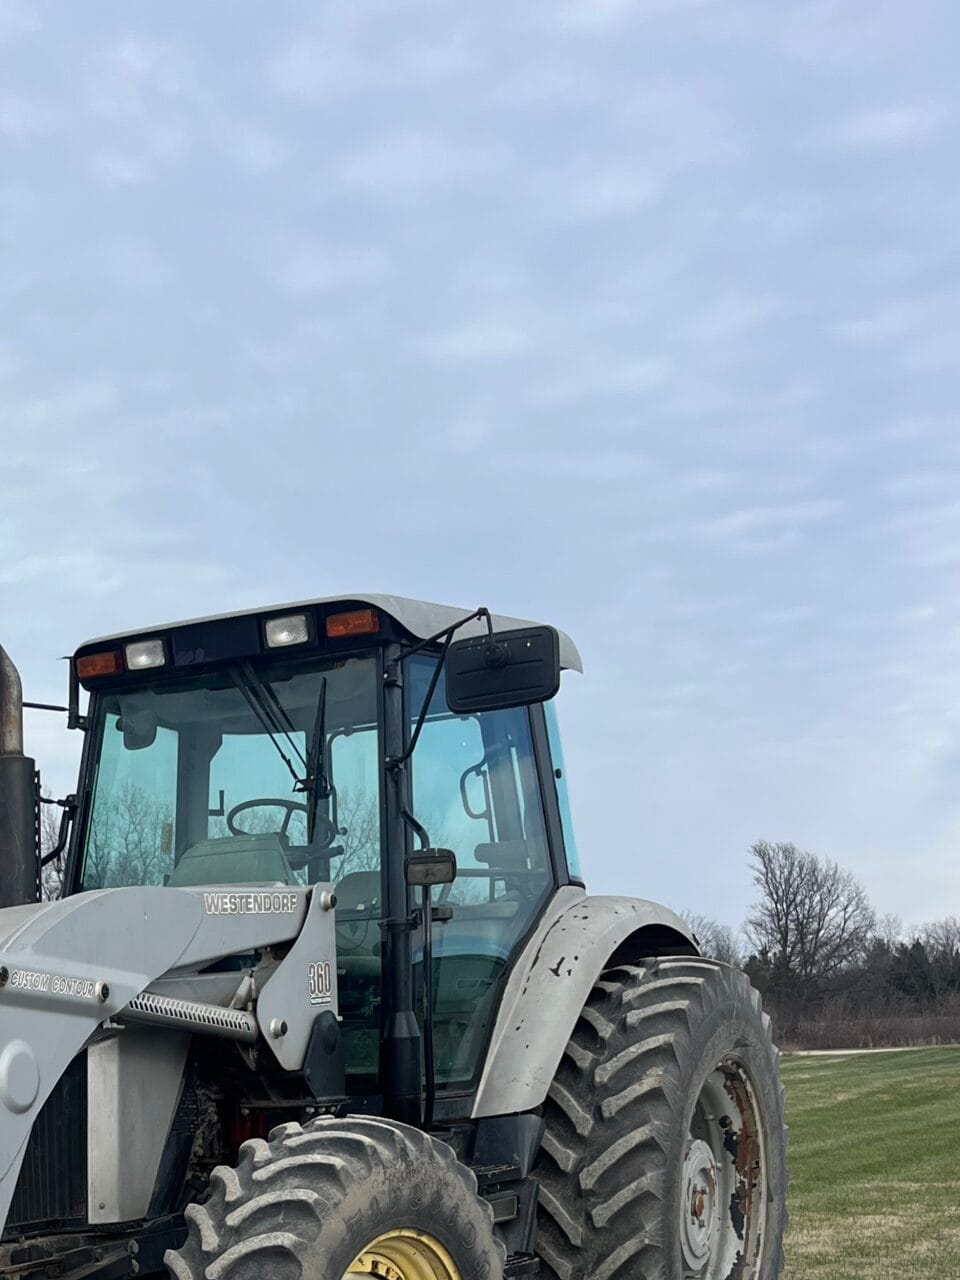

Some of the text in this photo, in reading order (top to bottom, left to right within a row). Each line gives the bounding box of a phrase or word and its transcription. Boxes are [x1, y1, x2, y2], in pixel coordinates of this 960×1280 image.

[204, 893, 297, 914] WESTENDORF
[10, 969, 95, 998] CUSTOM CONTOUR
[308, 961, 332, 995] 360
